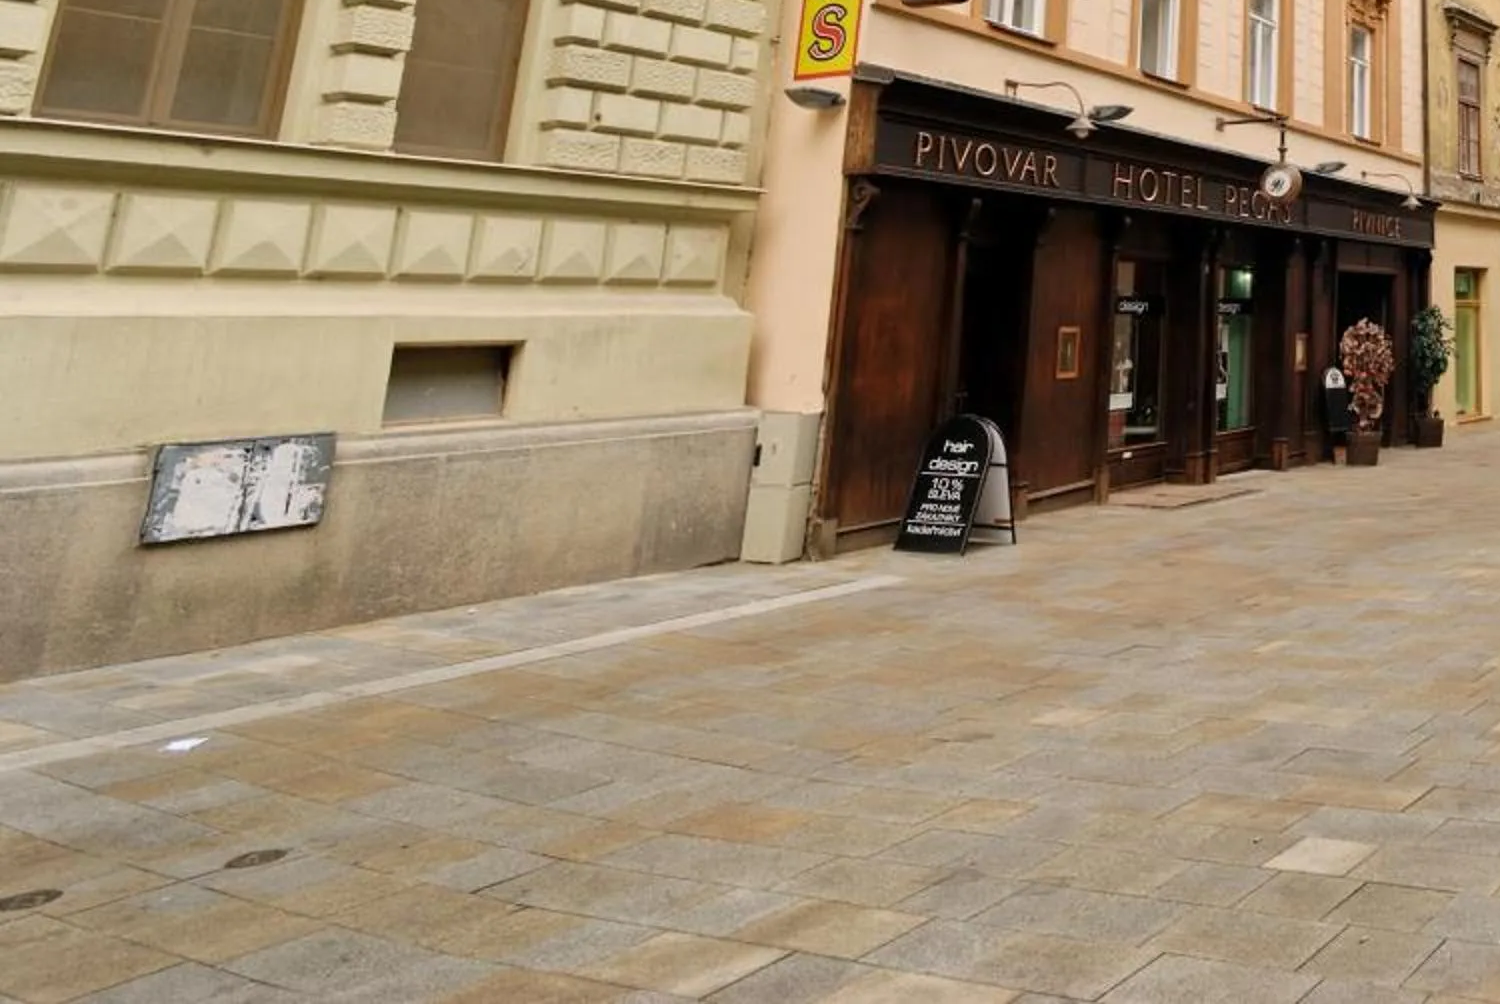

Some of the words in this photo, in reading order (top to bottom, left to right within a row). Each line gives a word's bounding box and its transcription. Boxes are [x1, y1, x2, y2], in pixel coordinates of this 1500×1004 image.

[915, 130, 1061, 189] PIVOVAR
[1113, 161, 1209, 211] HOTEL
[943, 439, 975, 453] hair
[928, 456, 979, 476] design
